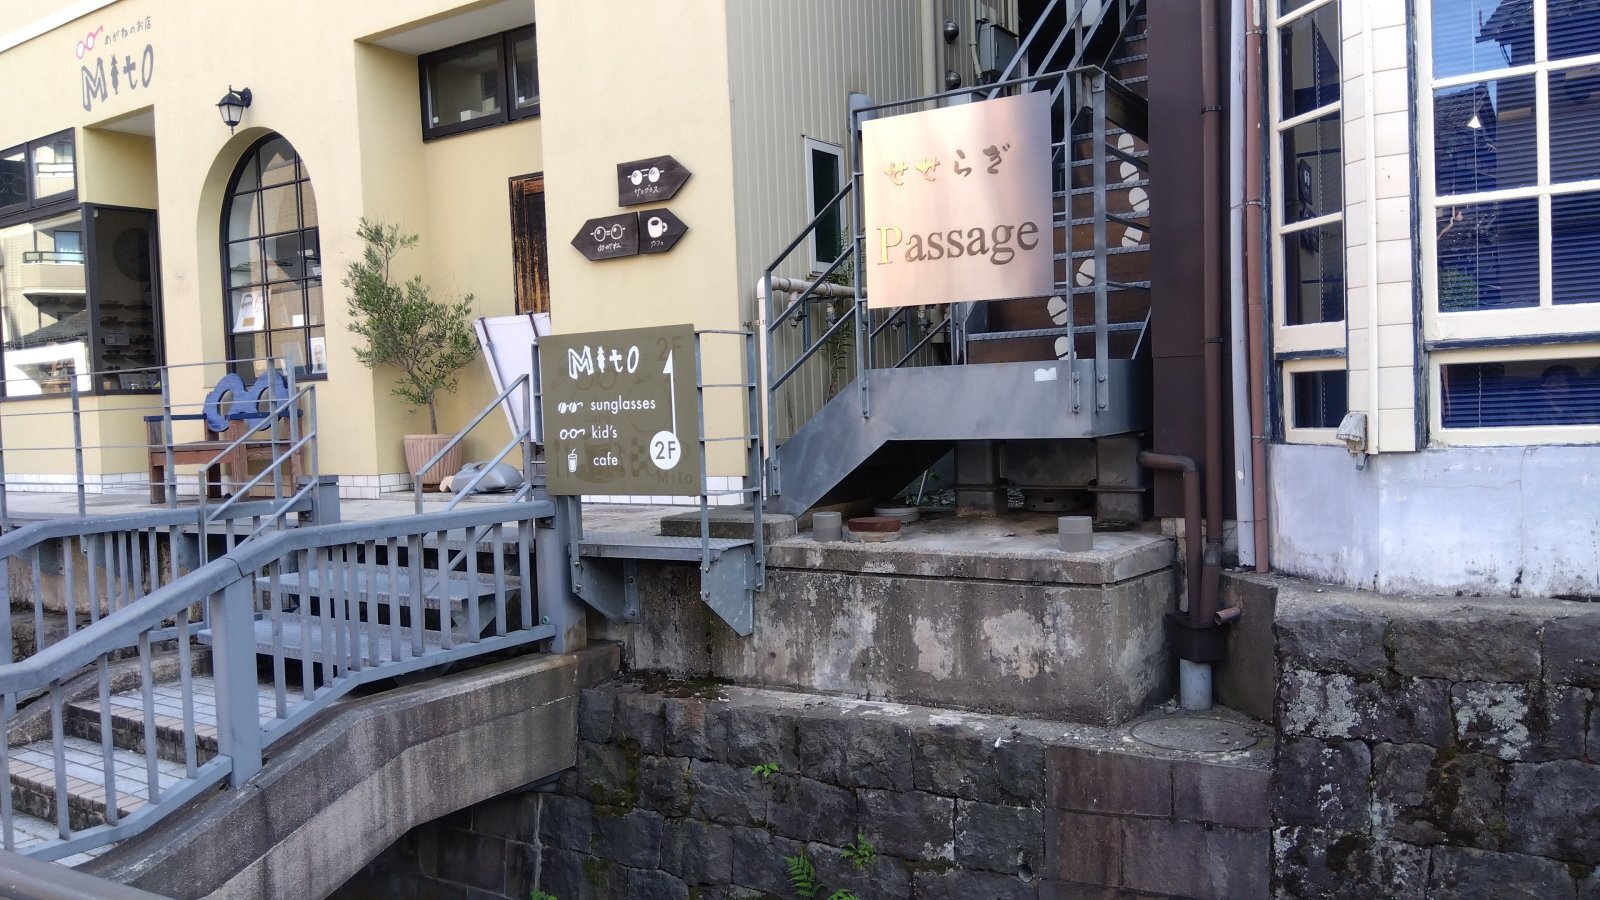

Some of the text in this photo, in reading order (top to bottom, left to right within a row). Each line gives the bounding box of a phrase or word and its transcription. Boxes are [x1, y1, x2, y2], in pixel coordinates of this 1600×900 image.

[882, 143, 1011, 186] せせらぎ
[876, 221, 1039, 265] Passage
[590, 395, 656, 414] sunglasses
[591, 425, 618, 439] kid's
[593, 452, 619, 466] cafe
[655, 441, 676, 460] 2F
